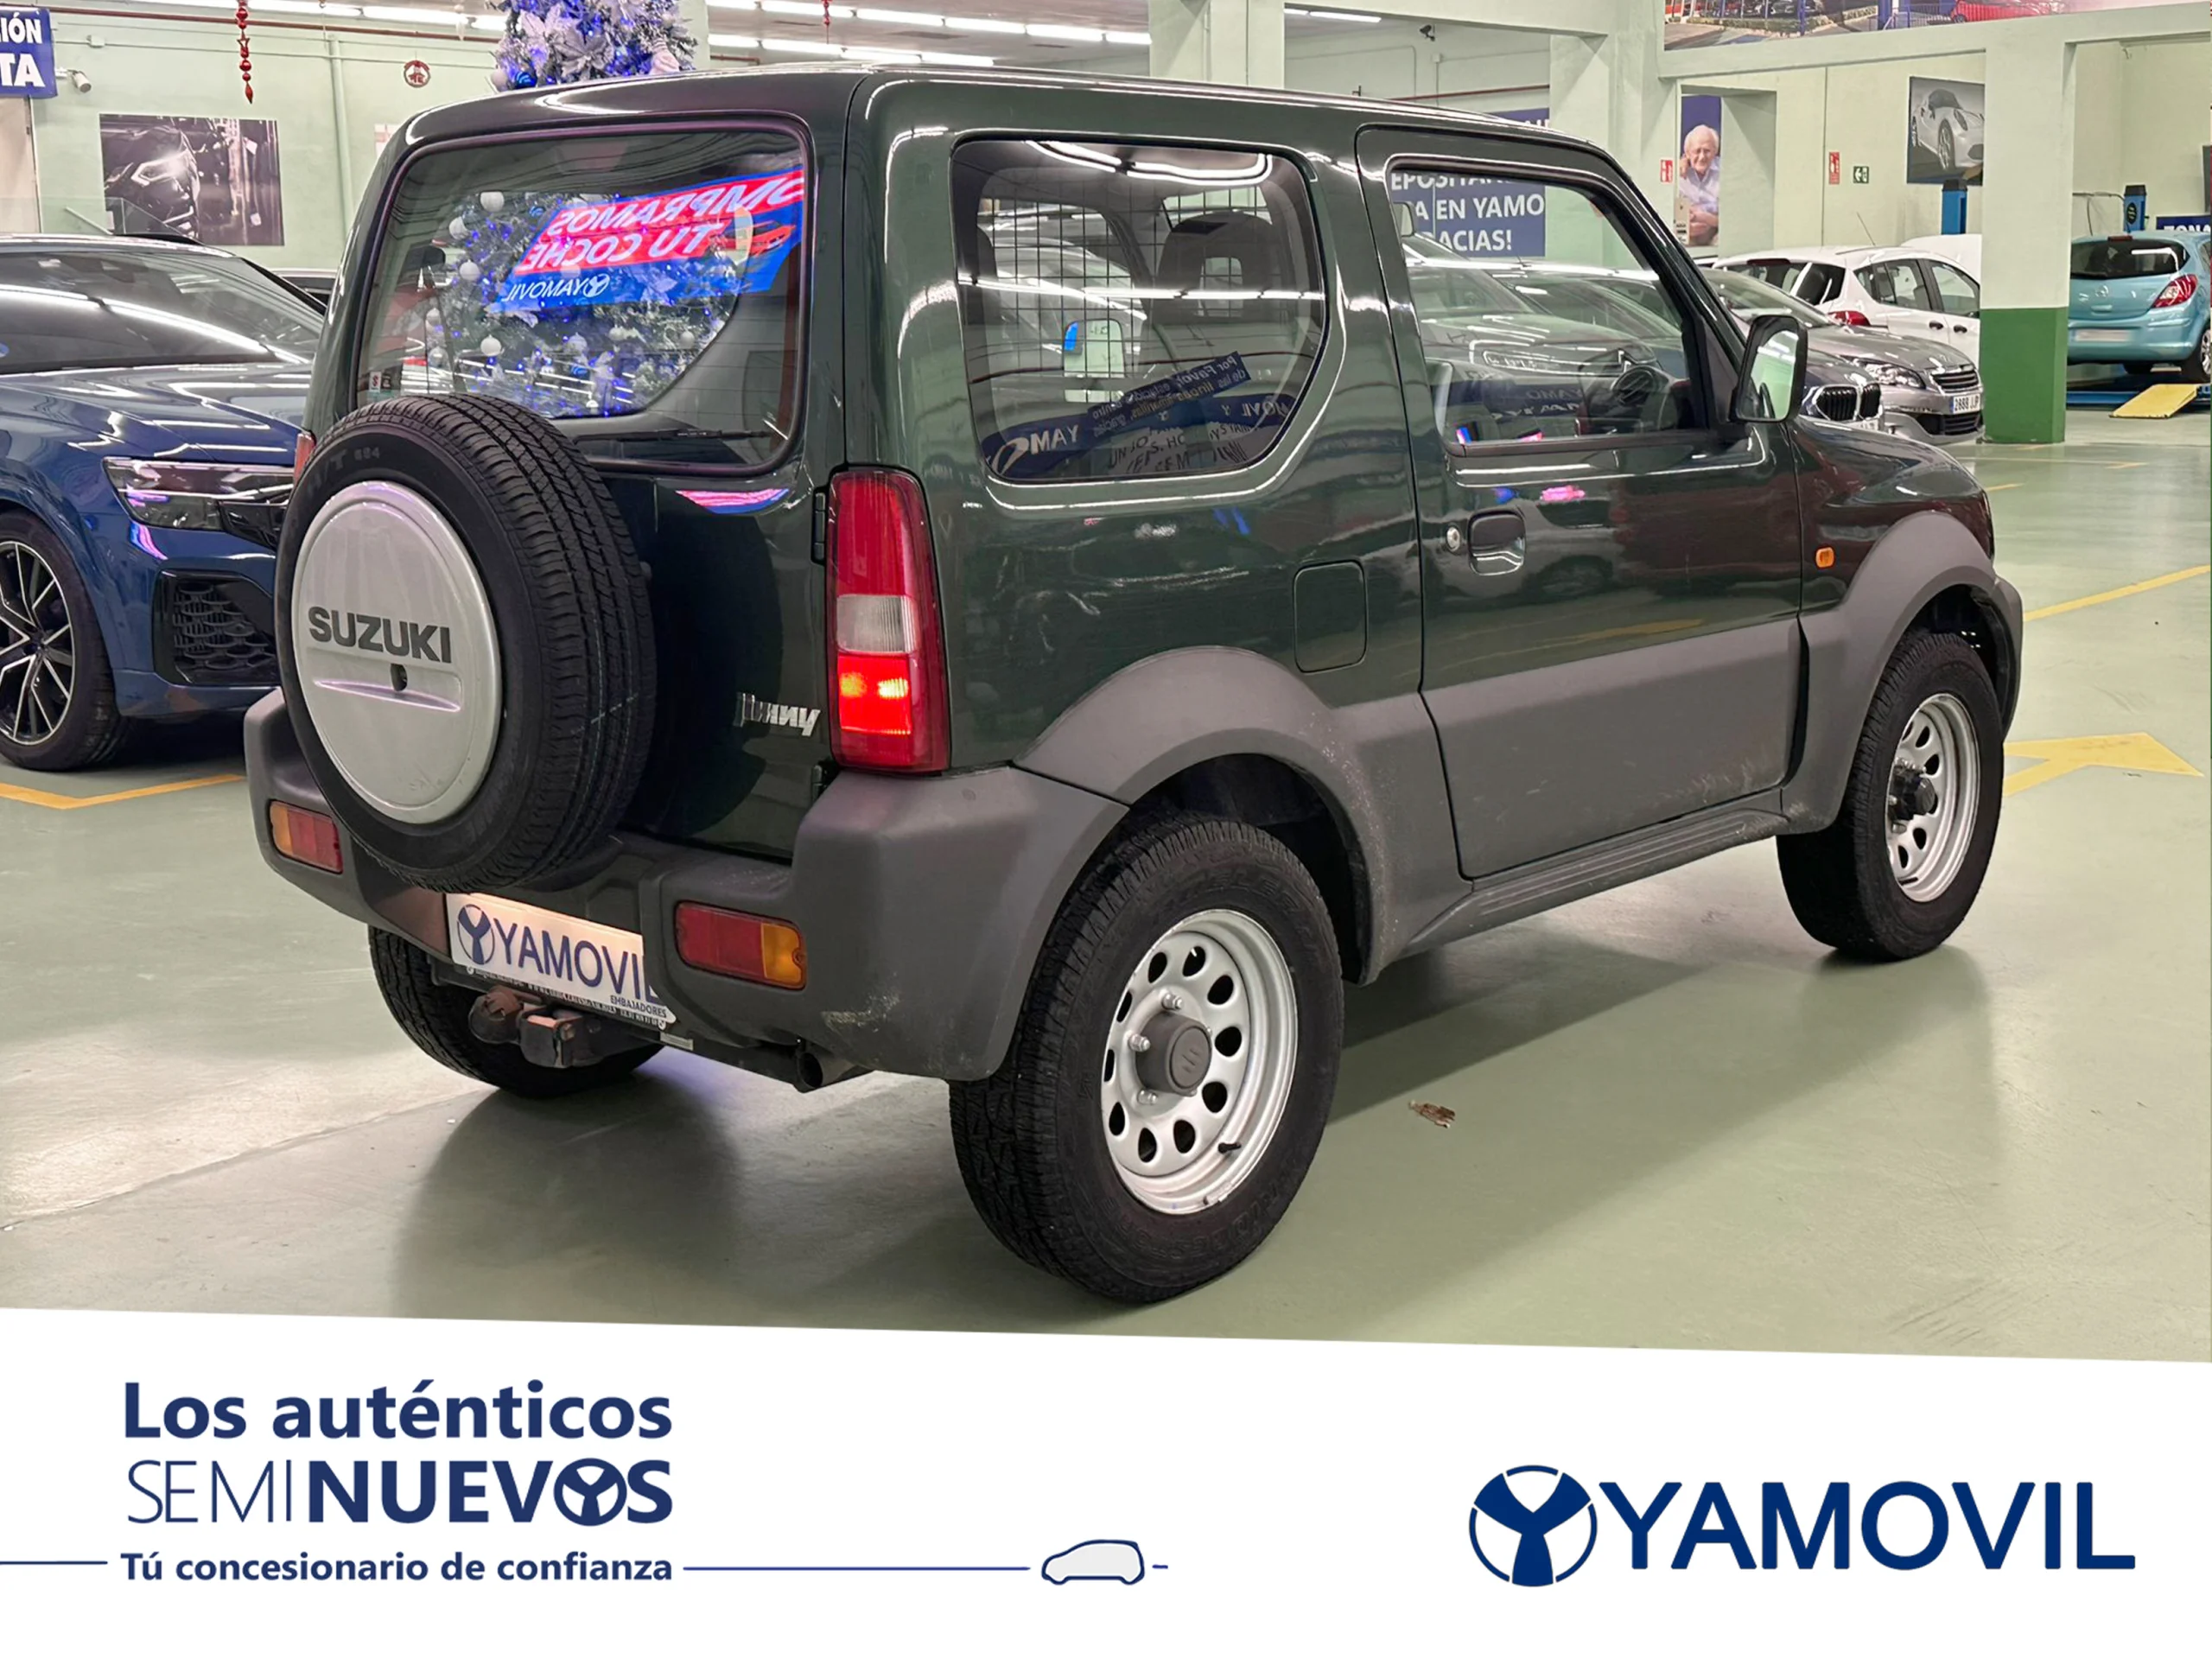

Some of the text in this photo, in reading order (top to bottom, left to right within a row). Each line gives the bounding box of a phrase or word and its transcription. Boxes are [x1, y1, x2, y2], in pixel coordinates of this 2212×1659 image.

[0, 11, 43, 44] IÓN
[1436, 199, 1466, 219] EN
[1472, 194, 1545, 219] YAMO
[1421, 229, 1512, 251] ACIAS!
[308, 607, 452, 664] SUZUKI
[610, 995, 668, 1019] EMBAJADORES
